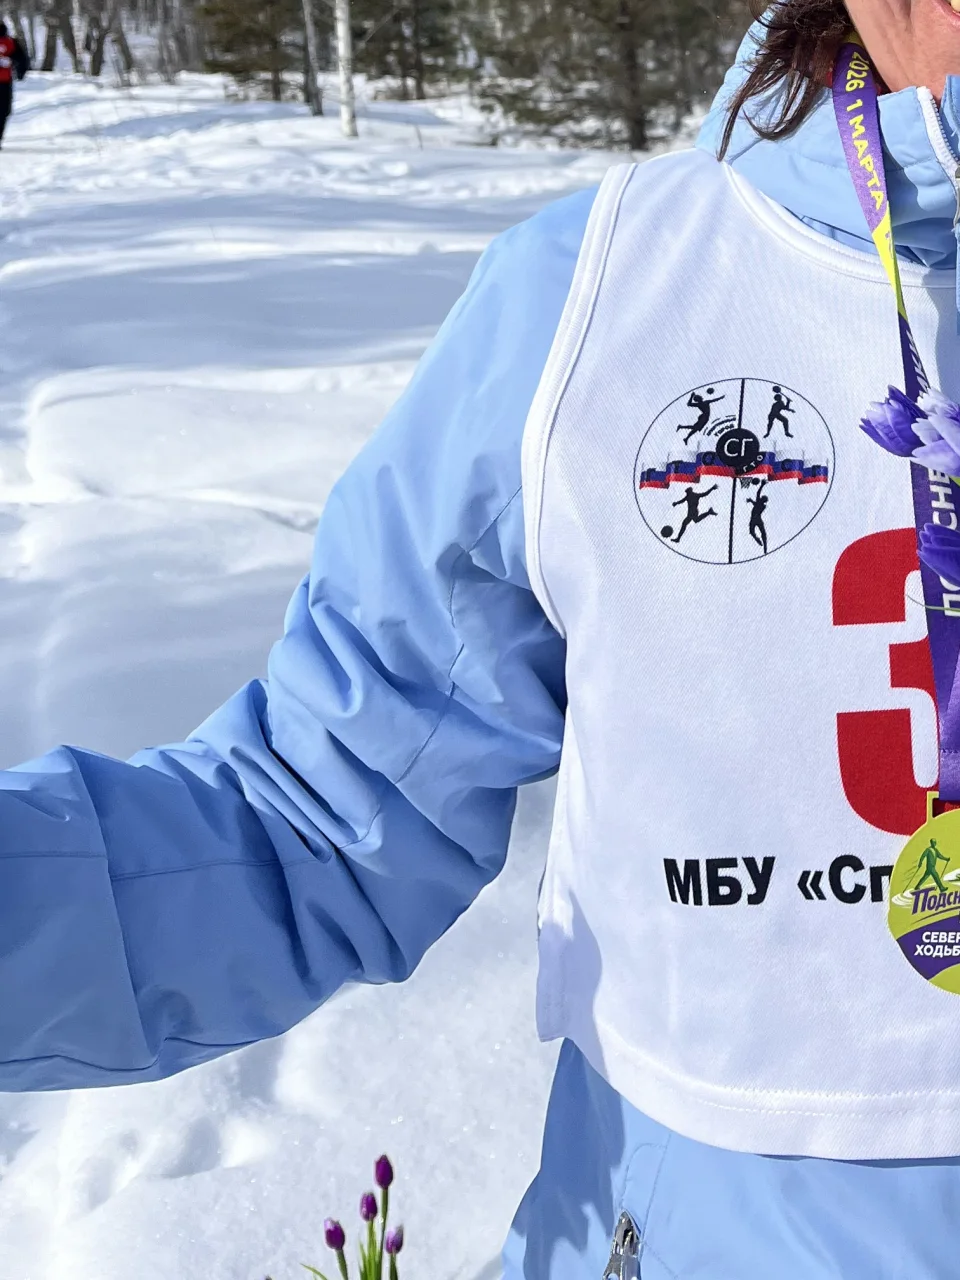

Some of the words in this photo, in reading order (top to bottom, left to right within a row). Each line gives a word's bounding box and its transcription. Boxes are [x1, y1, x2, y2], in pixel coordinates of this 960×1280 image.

[844, 51, 870, 92] 2026
[849, 114, 885, 210] МАРТА
[663, 856, 776, 906] МБУ
